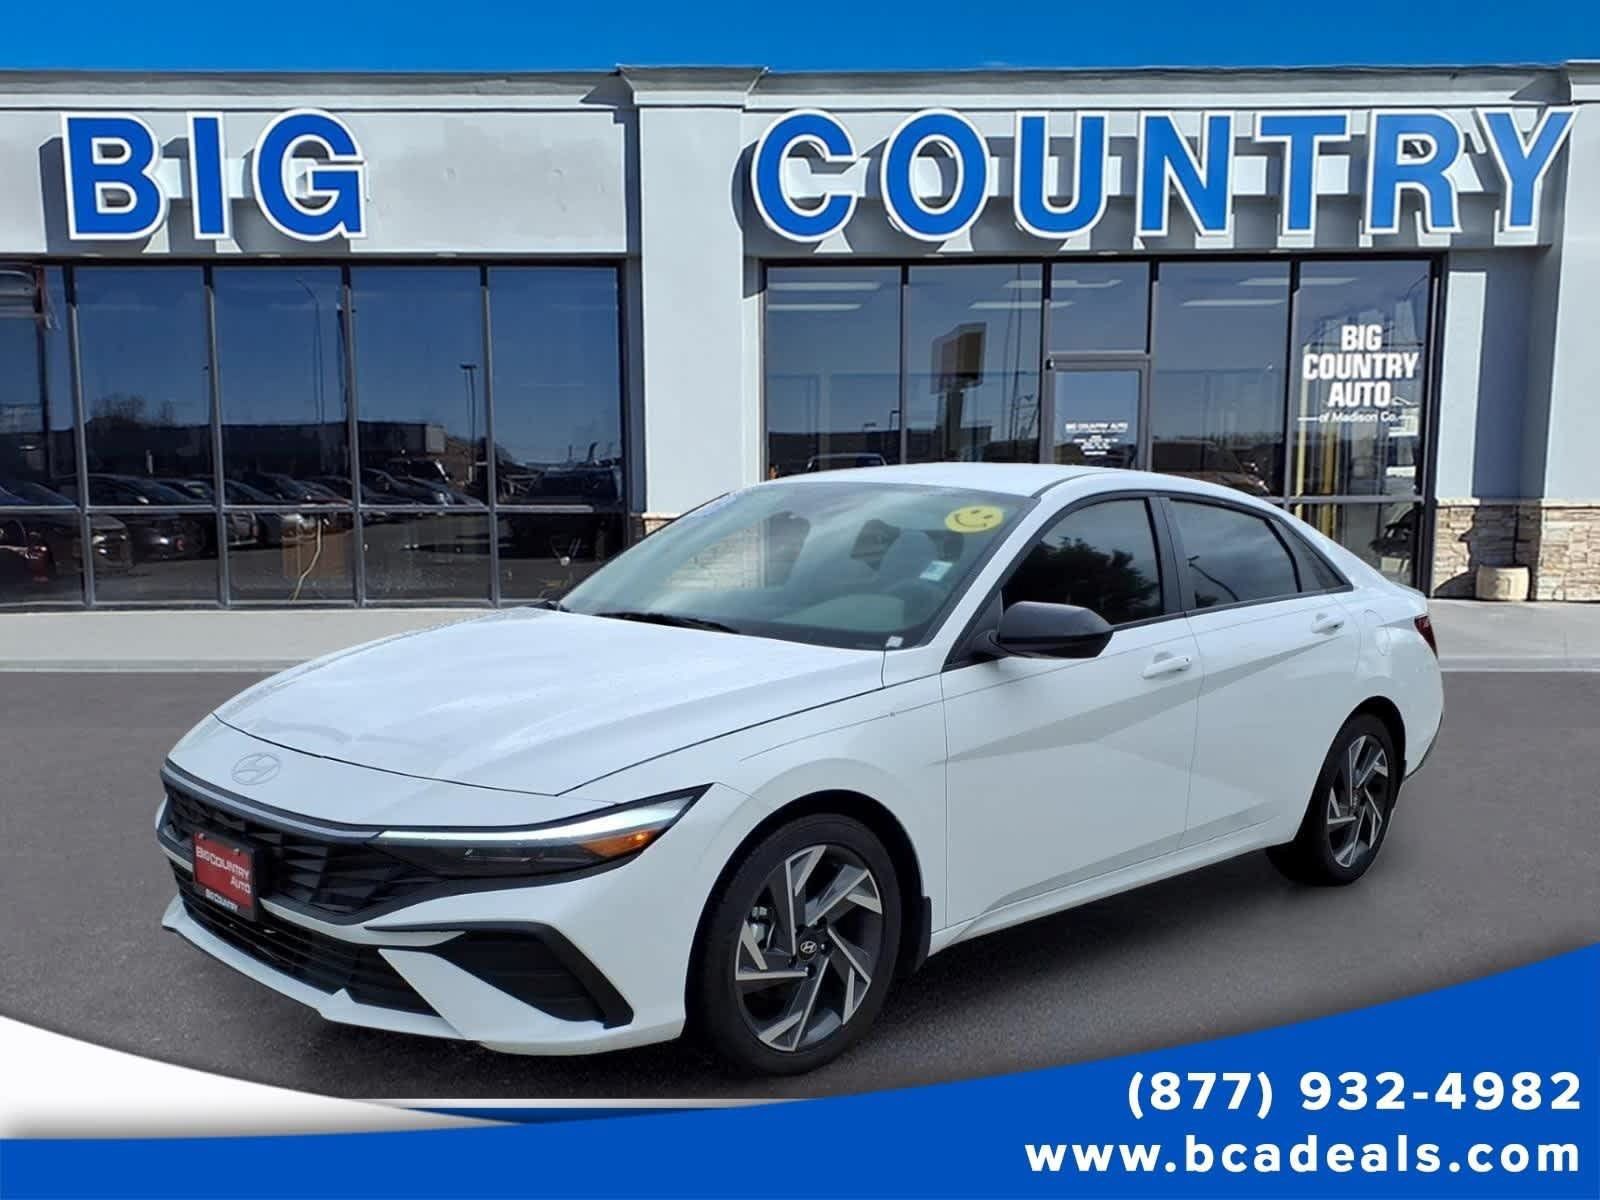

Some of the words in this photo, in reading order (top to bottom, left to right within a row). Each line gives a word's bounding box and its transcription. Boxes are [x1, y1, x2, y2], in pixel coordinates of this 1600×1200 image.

[61, 108, 367, 241] BIG
[750, 107, 1574, 242] COUNTRY
[1341, 324, 1382, 351] BIG
[1303, 352, 1419, 380] COUNTRY
[1327, 380, 1392, 407] AUTO
[1330, 411, 1377, 422] Madison
[230, 875, 252, 896] AUTO
